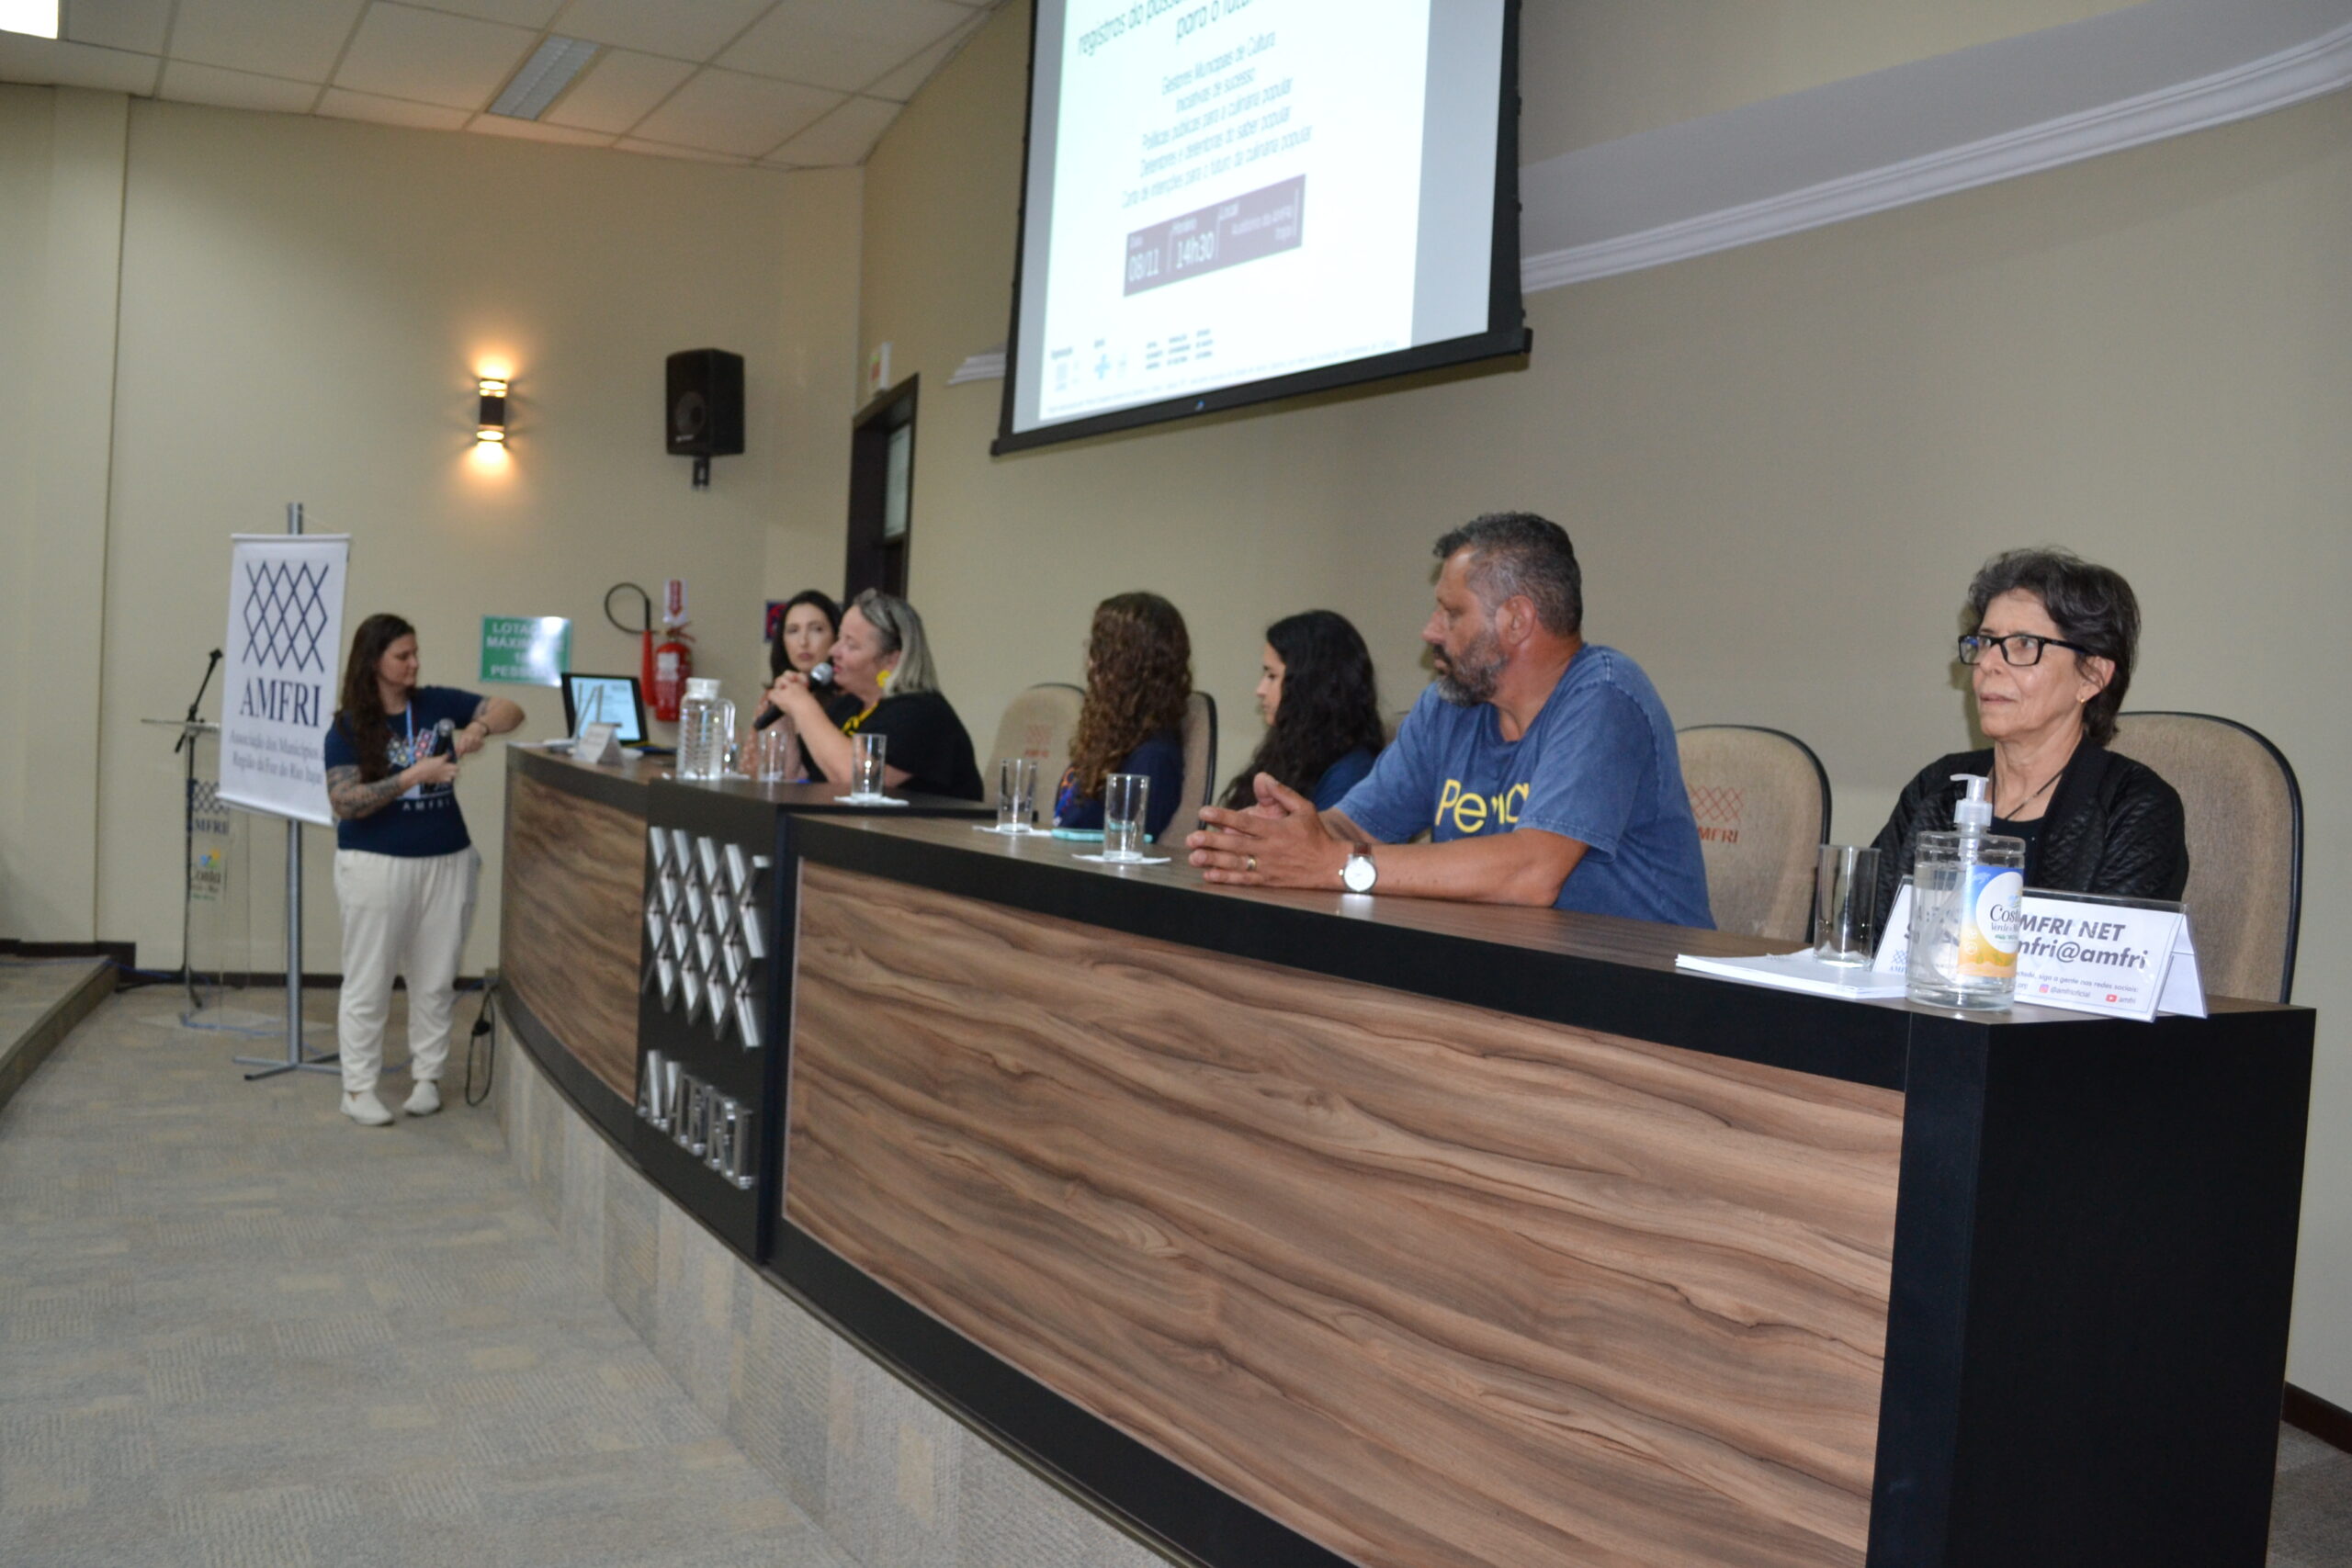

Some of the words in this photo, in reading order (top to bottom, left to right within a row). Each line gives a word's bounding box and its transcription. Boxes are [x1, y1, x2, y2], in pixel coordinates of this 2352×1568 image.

[1176, 6, 1207, 44] para
[1176, 231, 1215, 269] 14h30
[240, 677, 322, 728] AMFRI
[195, 818, 229, 835] MFRI
[1697, 826, 1739, 844] MFRI
[2018, 914, 2073, 936] MFRI
[2078, 920, 2126, 942] NET
[2018, 937, 2148, 969] mfri@amfri
[2039, 974, 2052, 982] siga
[2060, 976, 2078, 985] gente
[2094, 980, 2112, 989] redes
